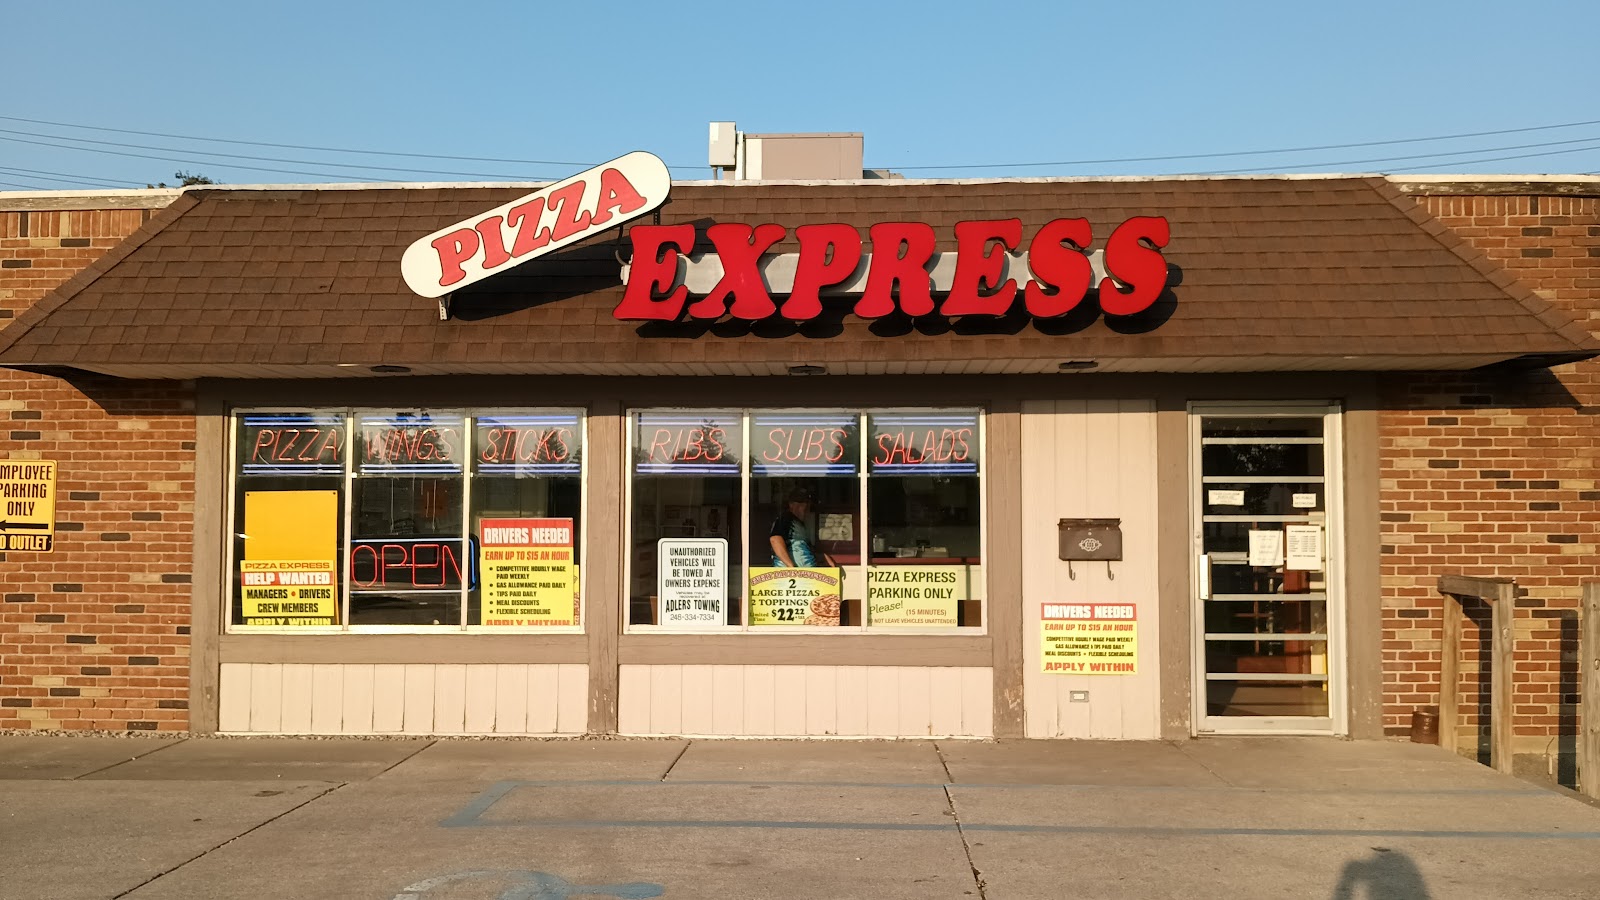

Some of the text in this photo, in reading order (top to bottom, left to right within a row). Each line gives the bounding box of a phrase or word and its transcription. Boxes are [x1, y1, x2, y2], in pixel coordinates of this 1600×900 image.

[431, 166, 647, 287] PIZZA
[612, 215, 1170, 321] EXPRESS
[252, 428, 337, 461] PIZZA
[366, 428, 457, 461] WINGS
[482, 428, 572, 461] STICKS
[650, 428, 726, 461] RIBS
[763, 428, 847, 462] SUBS
[875, 428, 972, 465] SALADS
[0, 465, 52, 480] MPLOYEE
[7, 501, 35, 516] ONLY
[0, 535, 48, 550] O OUTLET
[484, 527, 569, 544] DRIVERS NEEDED
[485, 551, 569, 560] EARN UP TO $15 AN HOUR
[669, 547, 716, 556] UNAUTHORIZED
[351, 544, 462, 588] OPEN
[670, 558, 715, 567] VEHICLES WILL
[244, 572, 330, 585] HELP WANTED
[672, 569, 713, 577] BE TOWED AT
[867, 571, 956, 583] PIZZA EXPRESS
[665, 579, 720, 588] OWNERS EXPENSE
[789, 579, 797, 589] 2
[246, 589, 331, 599] MANAGERS DRIVERS
[869, 588, 953, 599] PARKING ONLY
[257, 603, 318, 613] CREW MEMBERS
[665, 599, 720, 613] ADLERS TOWING
[869, 600, 904, 615] Please!
[1044, 605, 1133, 618] DRIVERS NEEDED
[1045, 662, 1134, 671] APPLY WITHIN
